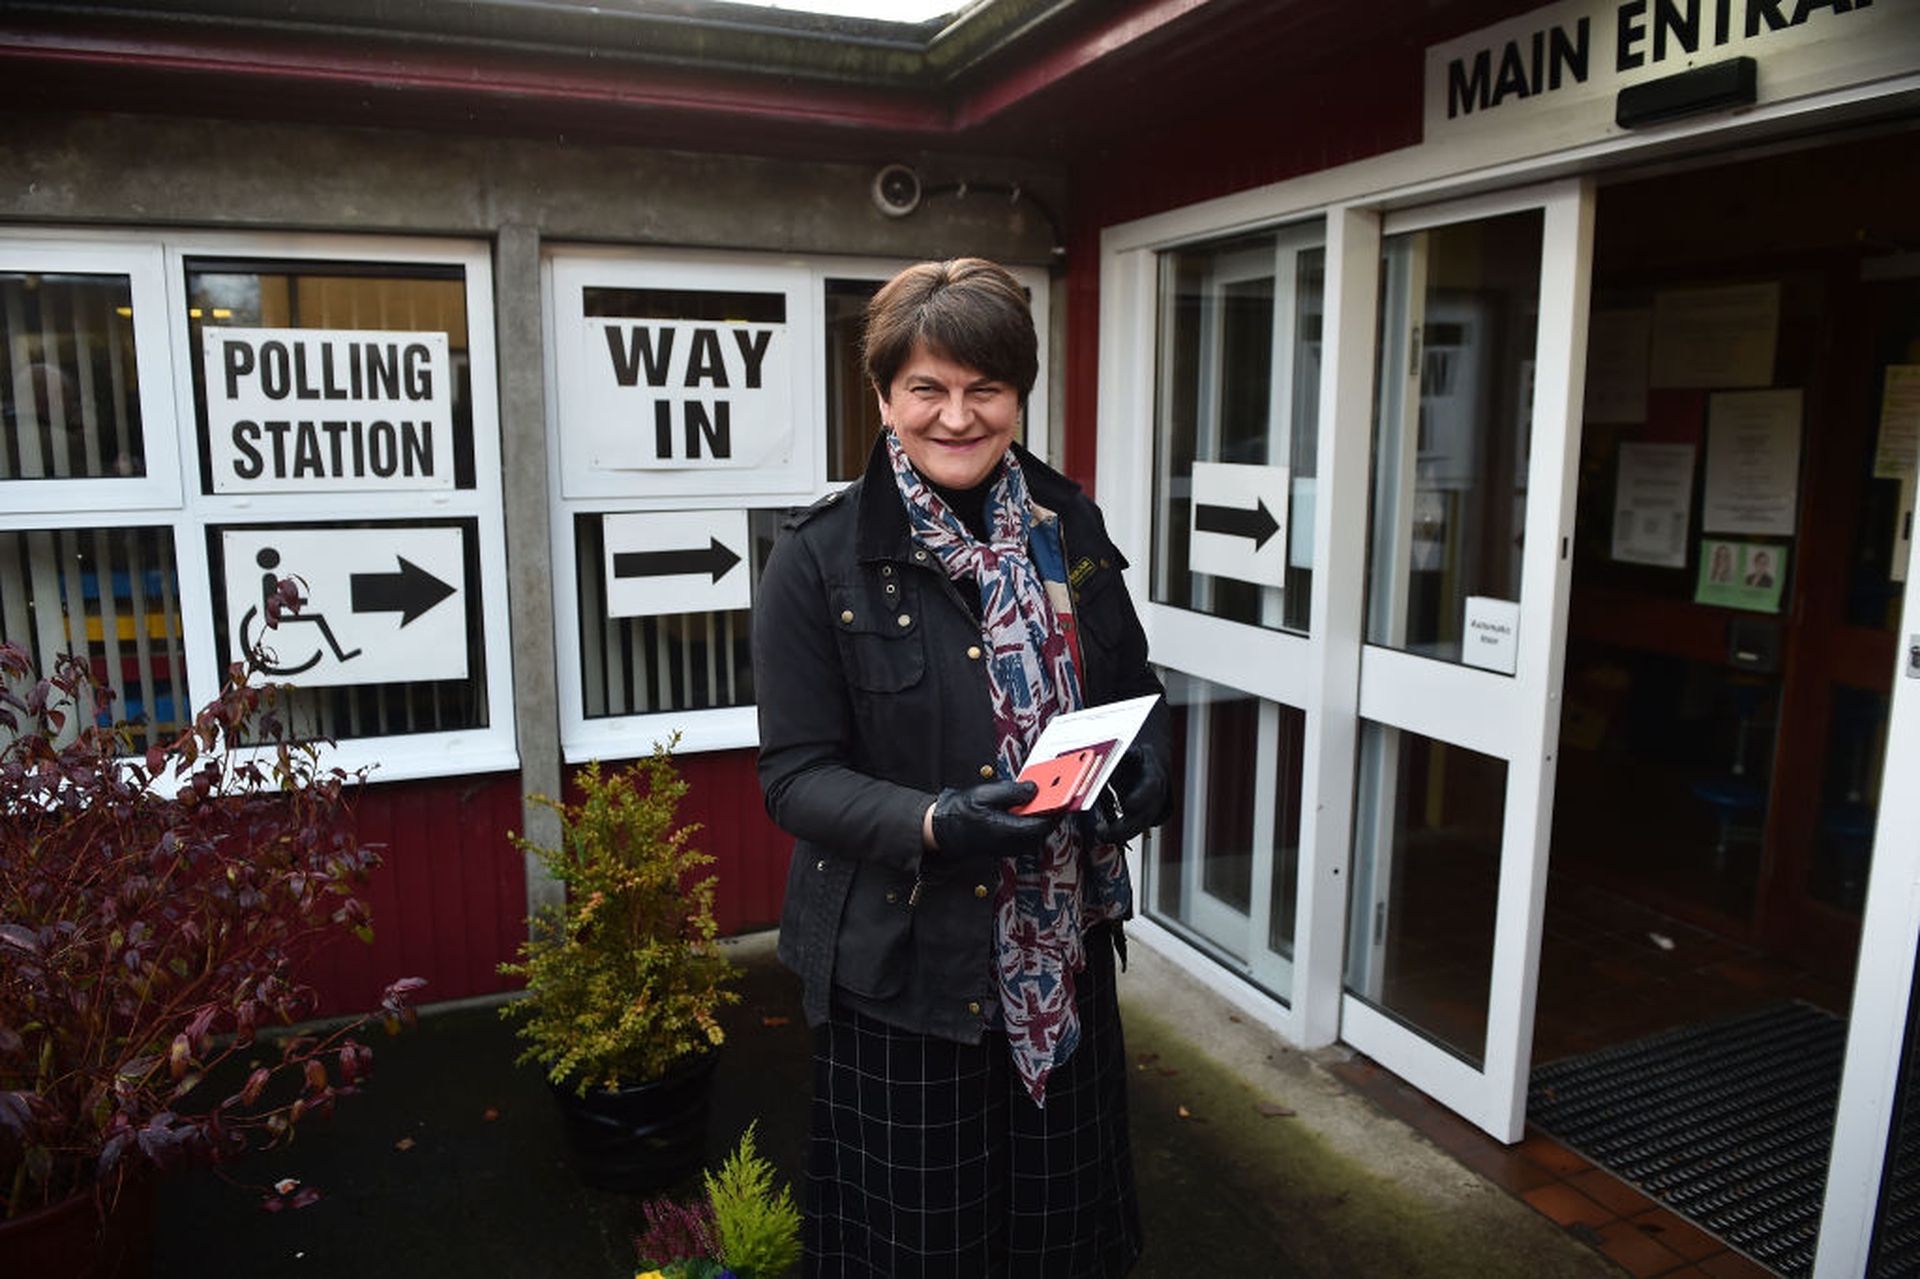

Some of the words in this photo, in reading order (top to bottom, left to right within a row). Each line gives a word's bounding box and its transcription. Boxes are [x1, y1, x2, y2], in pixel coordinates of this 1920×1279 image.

[1446, 16, 1591, 120] MAIN
[1616, 0, 1874, 73] ENTR
[223, 340, 433, 401] POLLING
[604, 325, 773, 389] WAY
[232, 420, 434, 480] STATION
[654, 399, 731, 460] IN
